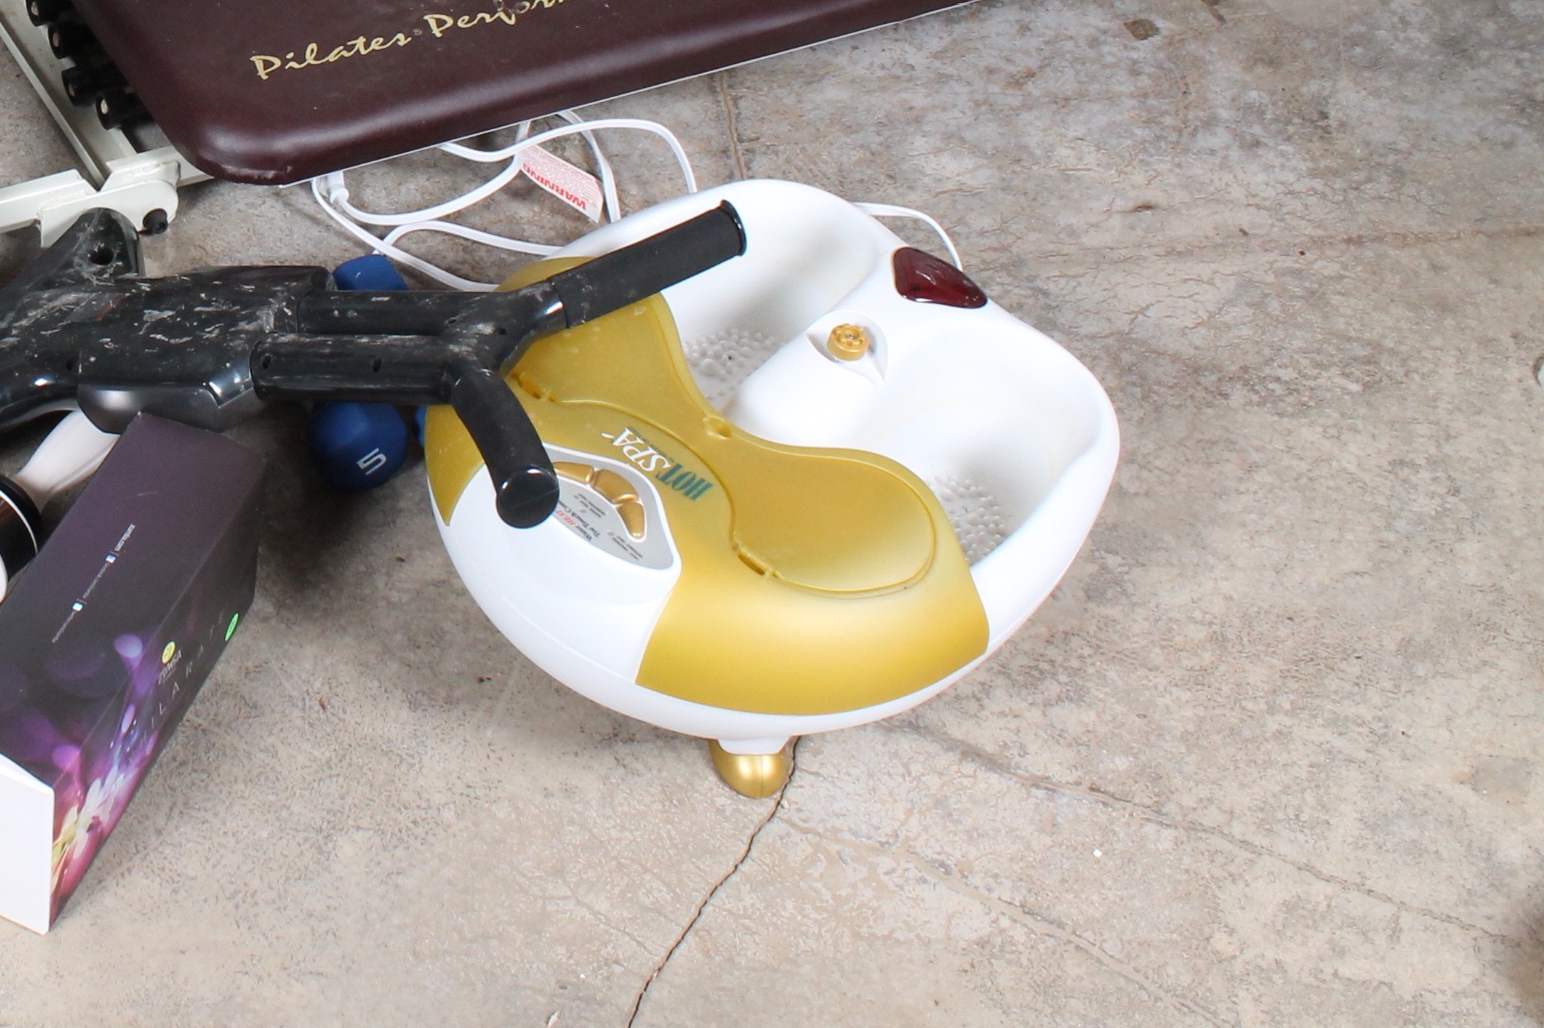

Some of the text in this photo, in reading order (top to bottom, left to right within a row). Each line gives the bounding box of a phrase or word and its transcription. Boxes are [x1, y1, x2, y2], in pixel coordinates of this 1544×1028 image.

[250, 31, 414, 80] Pilates
[356, 447, 387, 476] 5
[612, 428, 671, 472] SPA
[655, 463, 713, 501] HOT
